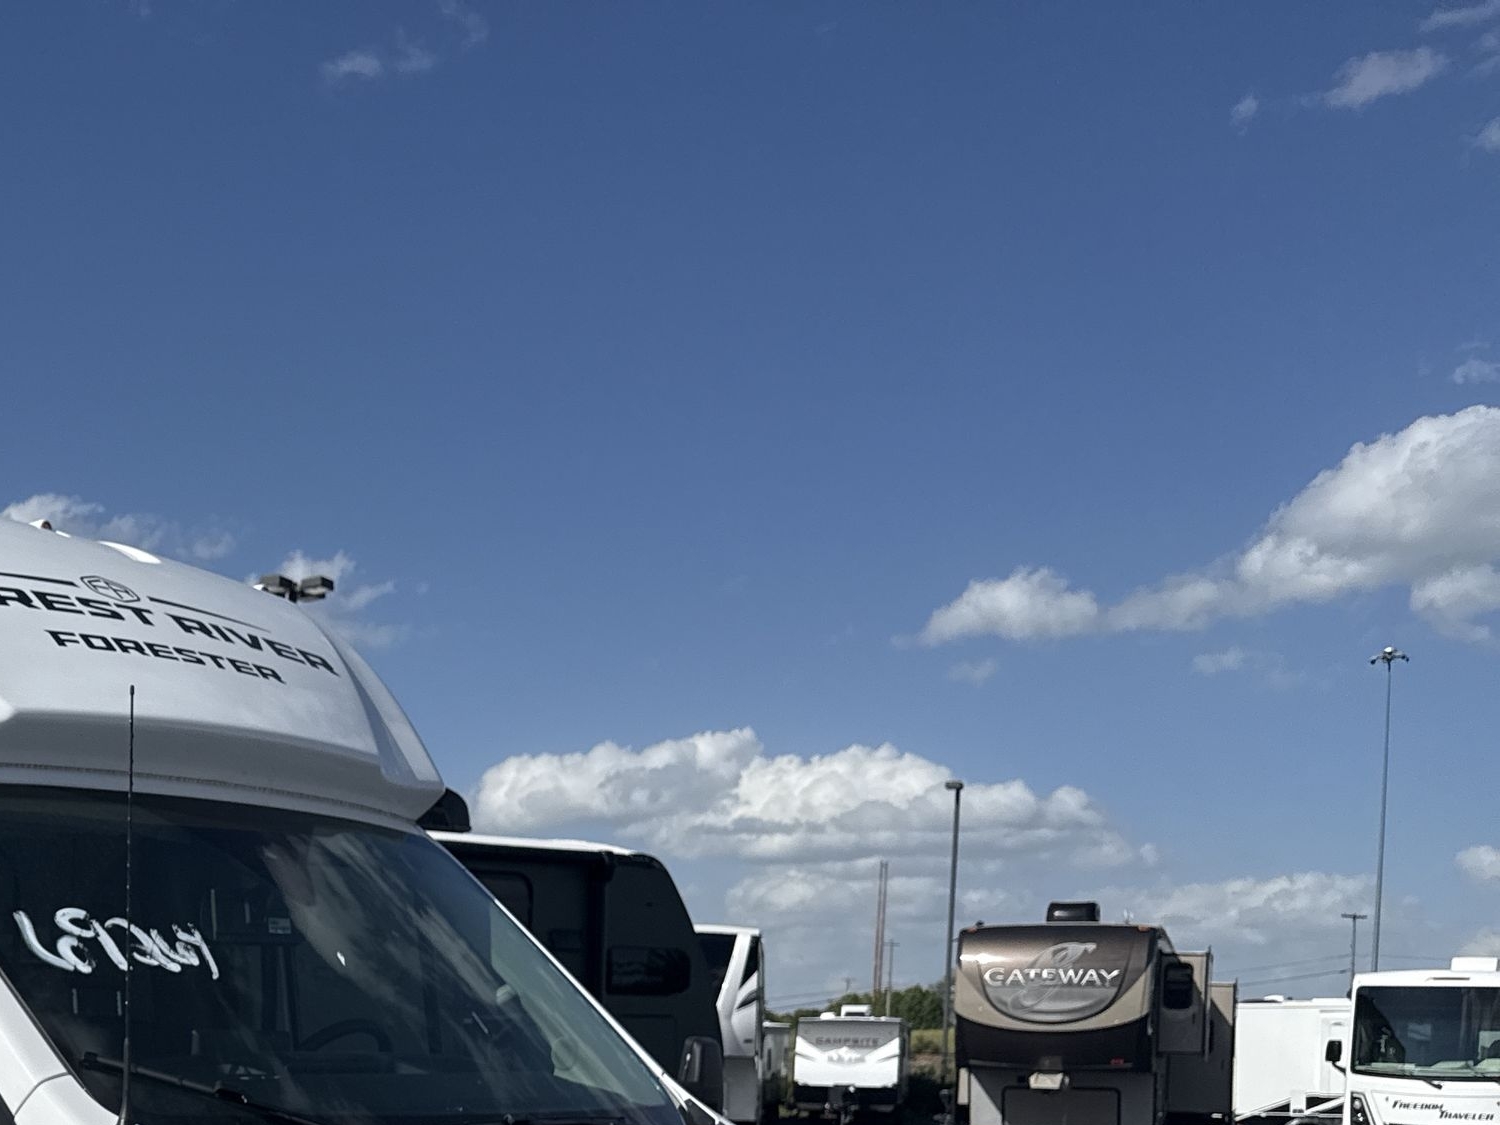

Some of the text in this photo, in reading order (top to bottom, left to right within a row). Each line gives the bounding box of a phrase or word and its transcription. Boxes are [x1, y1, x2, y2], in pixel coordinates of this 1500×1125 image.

[44, 629, 287, 684] FORESTER
[165, 612, 341, 676] RIVER
[983, 966, 1121, 987] GATEWAY
